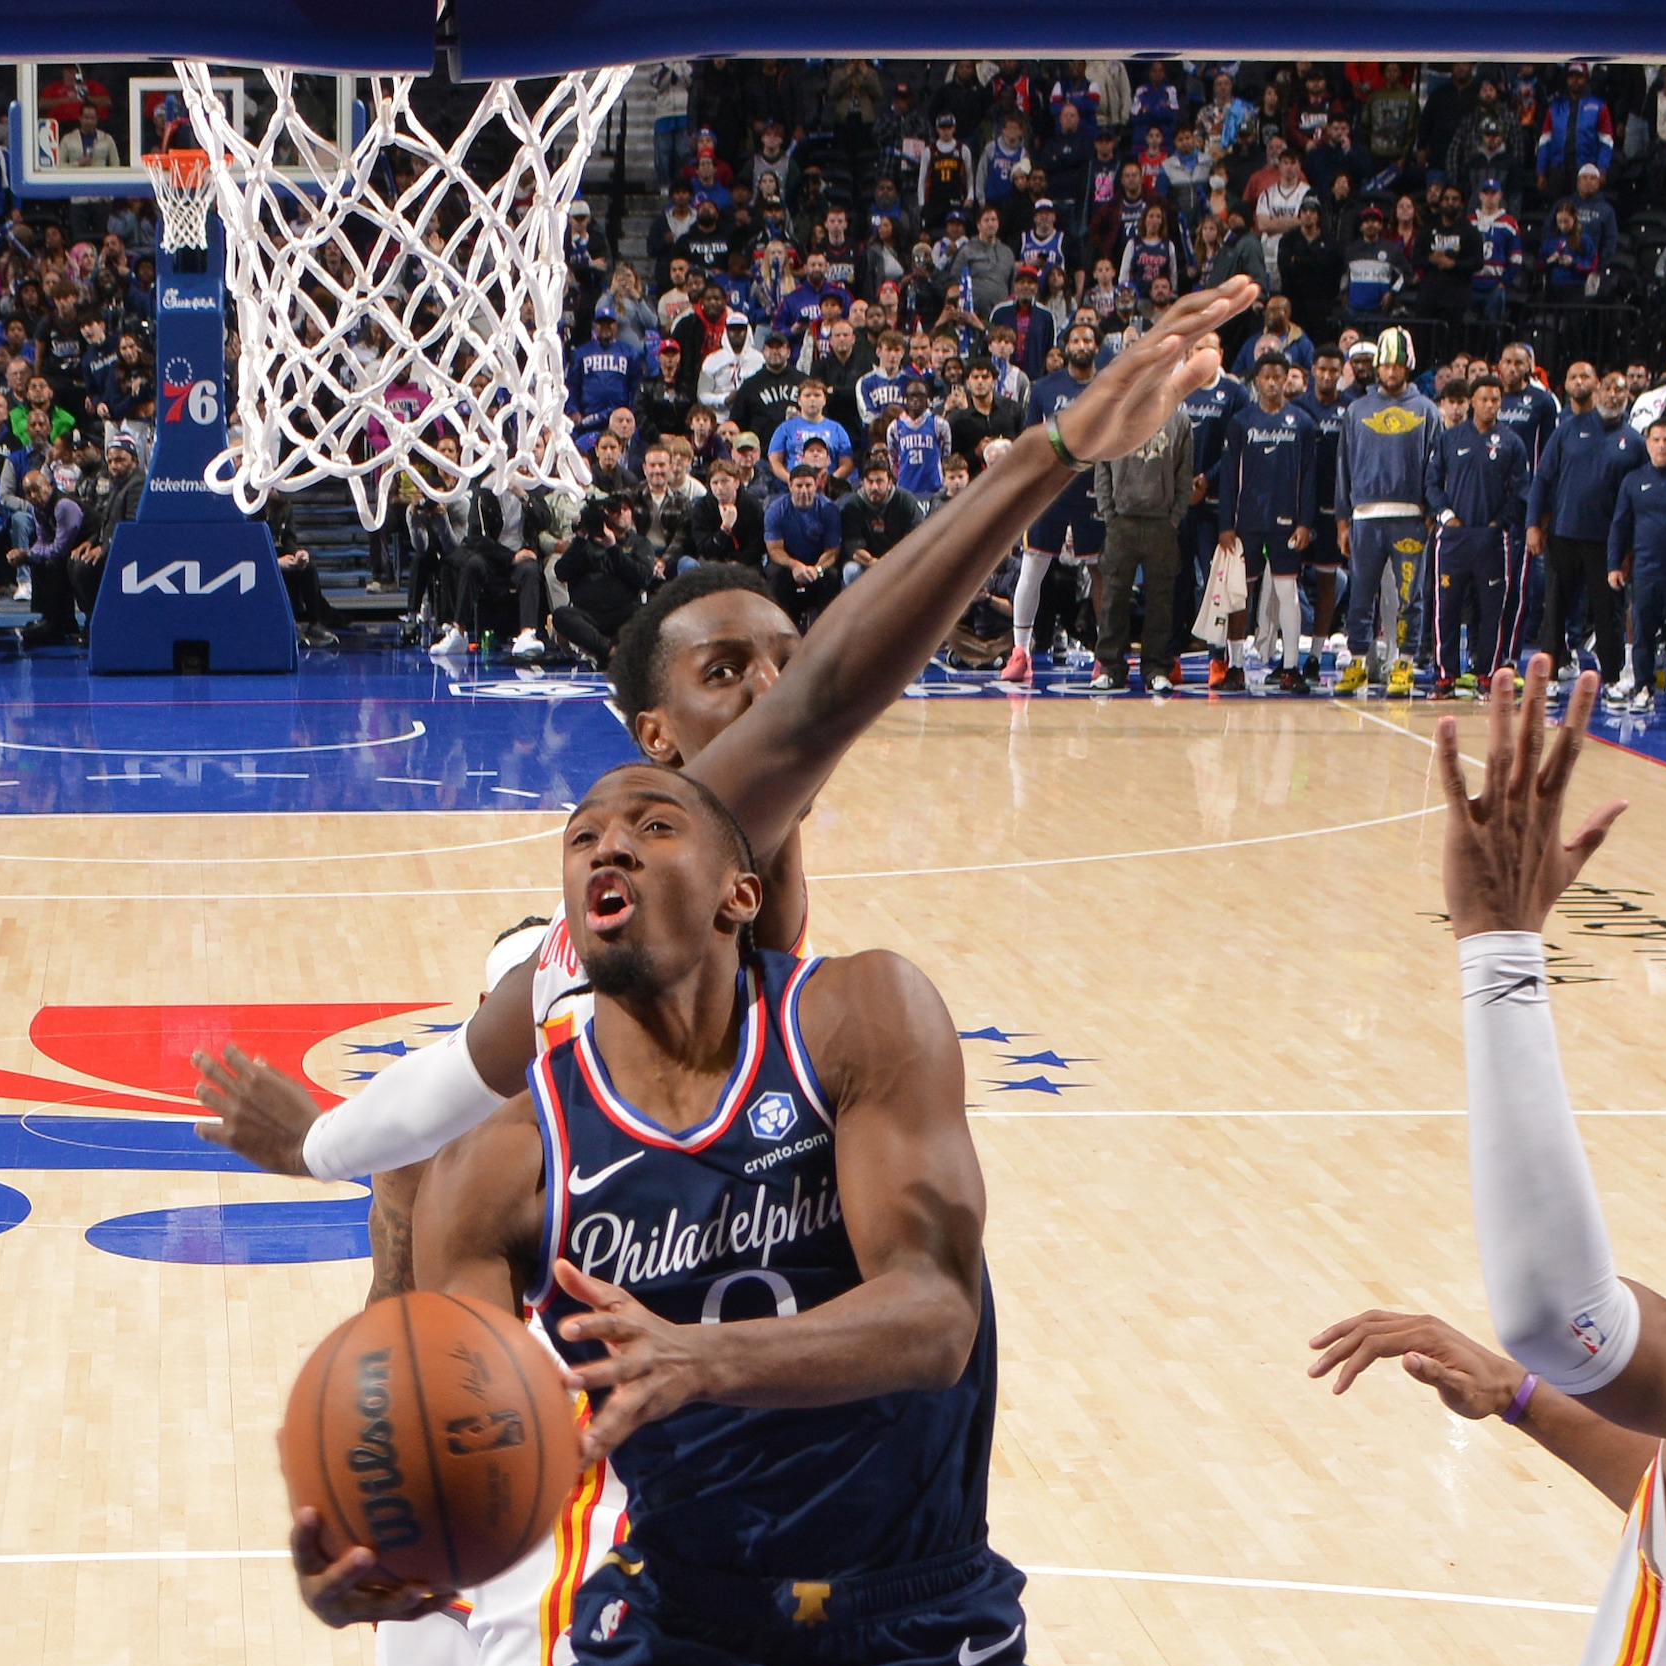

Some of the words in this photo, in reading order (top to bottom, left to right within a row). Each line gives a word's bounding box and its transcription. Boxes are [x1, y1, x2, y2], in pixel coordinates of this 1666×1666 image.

[163, 380, 219, 425] 76
[759, 385, 799, 406] NIKE
[868, 386, 906, 408] PHIL
[909, 448, 924, 464] 21
[150, 479, 209, 493] ticketmas
[744, 1131, 829, 1175] crypto.com
[348, 1346, 423, 1553] Wilson
